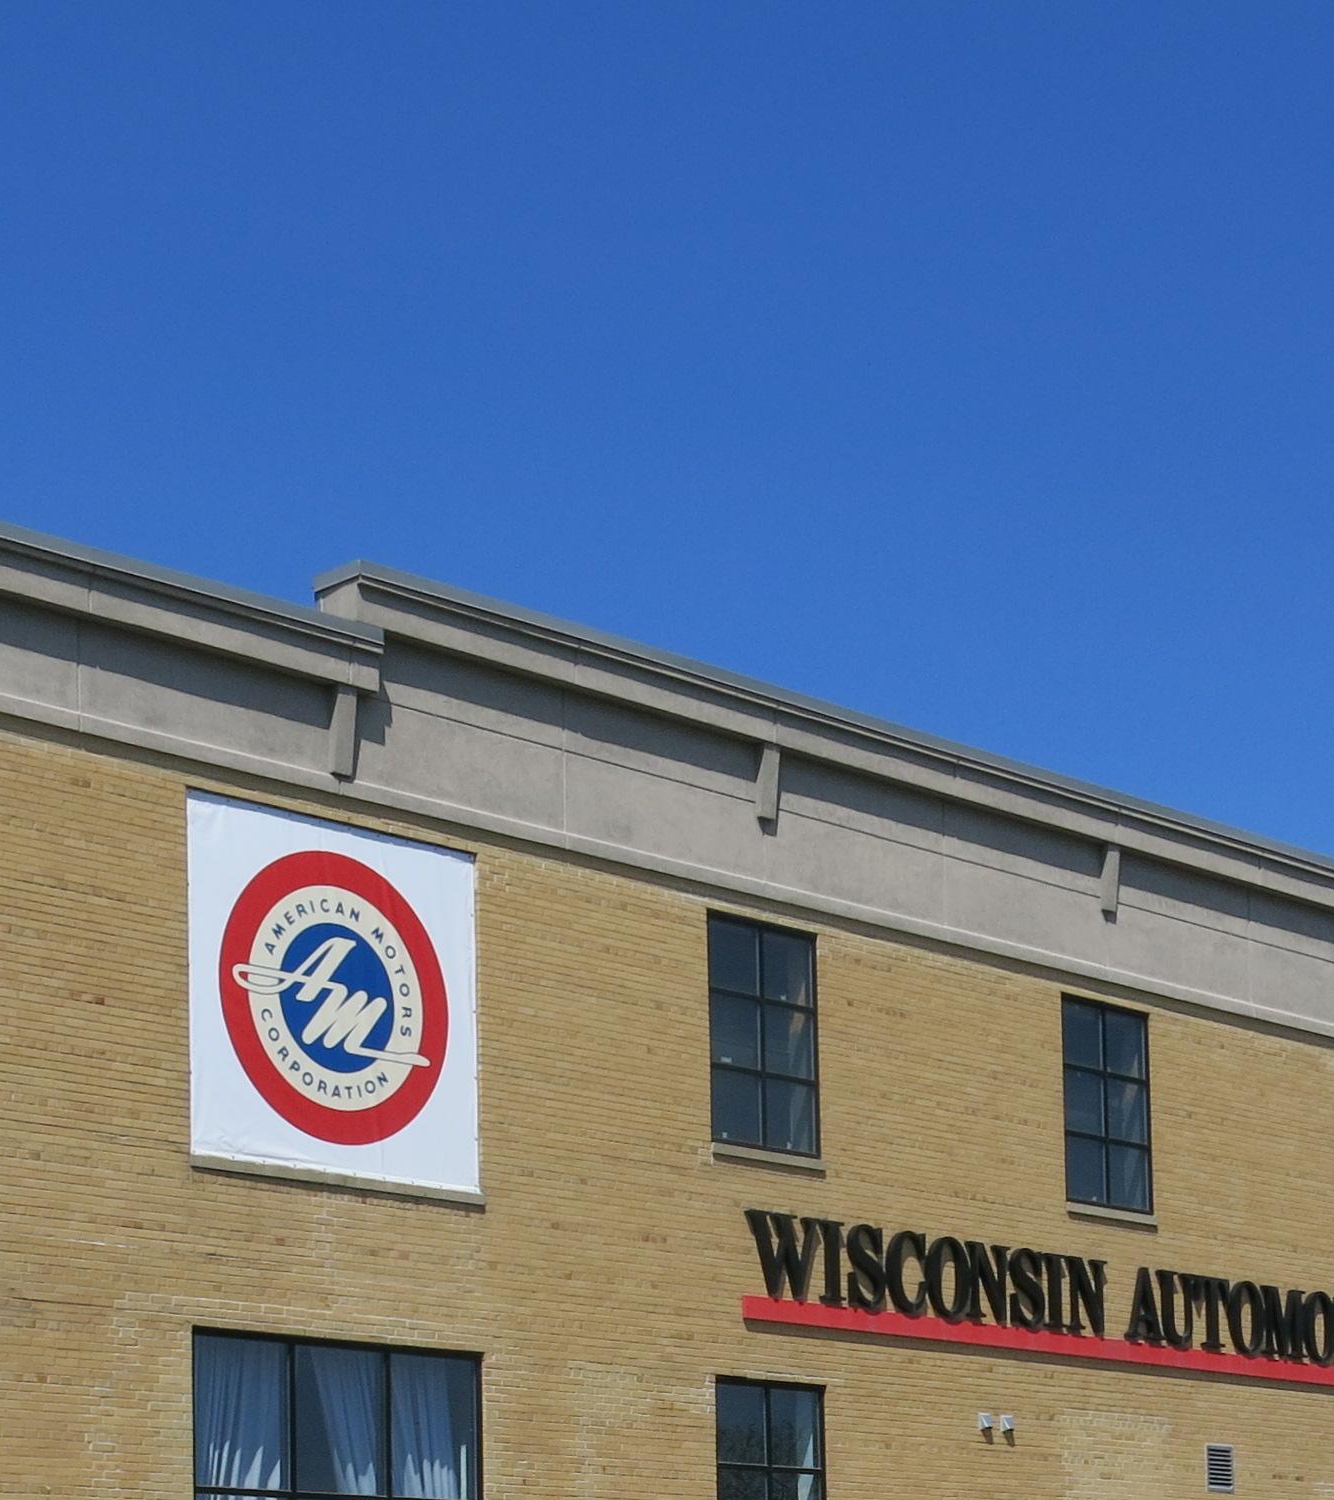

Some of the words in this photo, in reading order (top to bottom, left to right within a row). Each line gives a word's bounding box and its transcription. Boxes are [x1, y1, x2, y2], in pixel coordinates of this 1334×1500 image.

[264, 899, 361, 956] AMERICAN
[371, 926, 413, 1038] MOTORS
[261, 1008, 390, 1100] CORPORATION
[744, 1208, 1108, 1340] WISCONSIN
